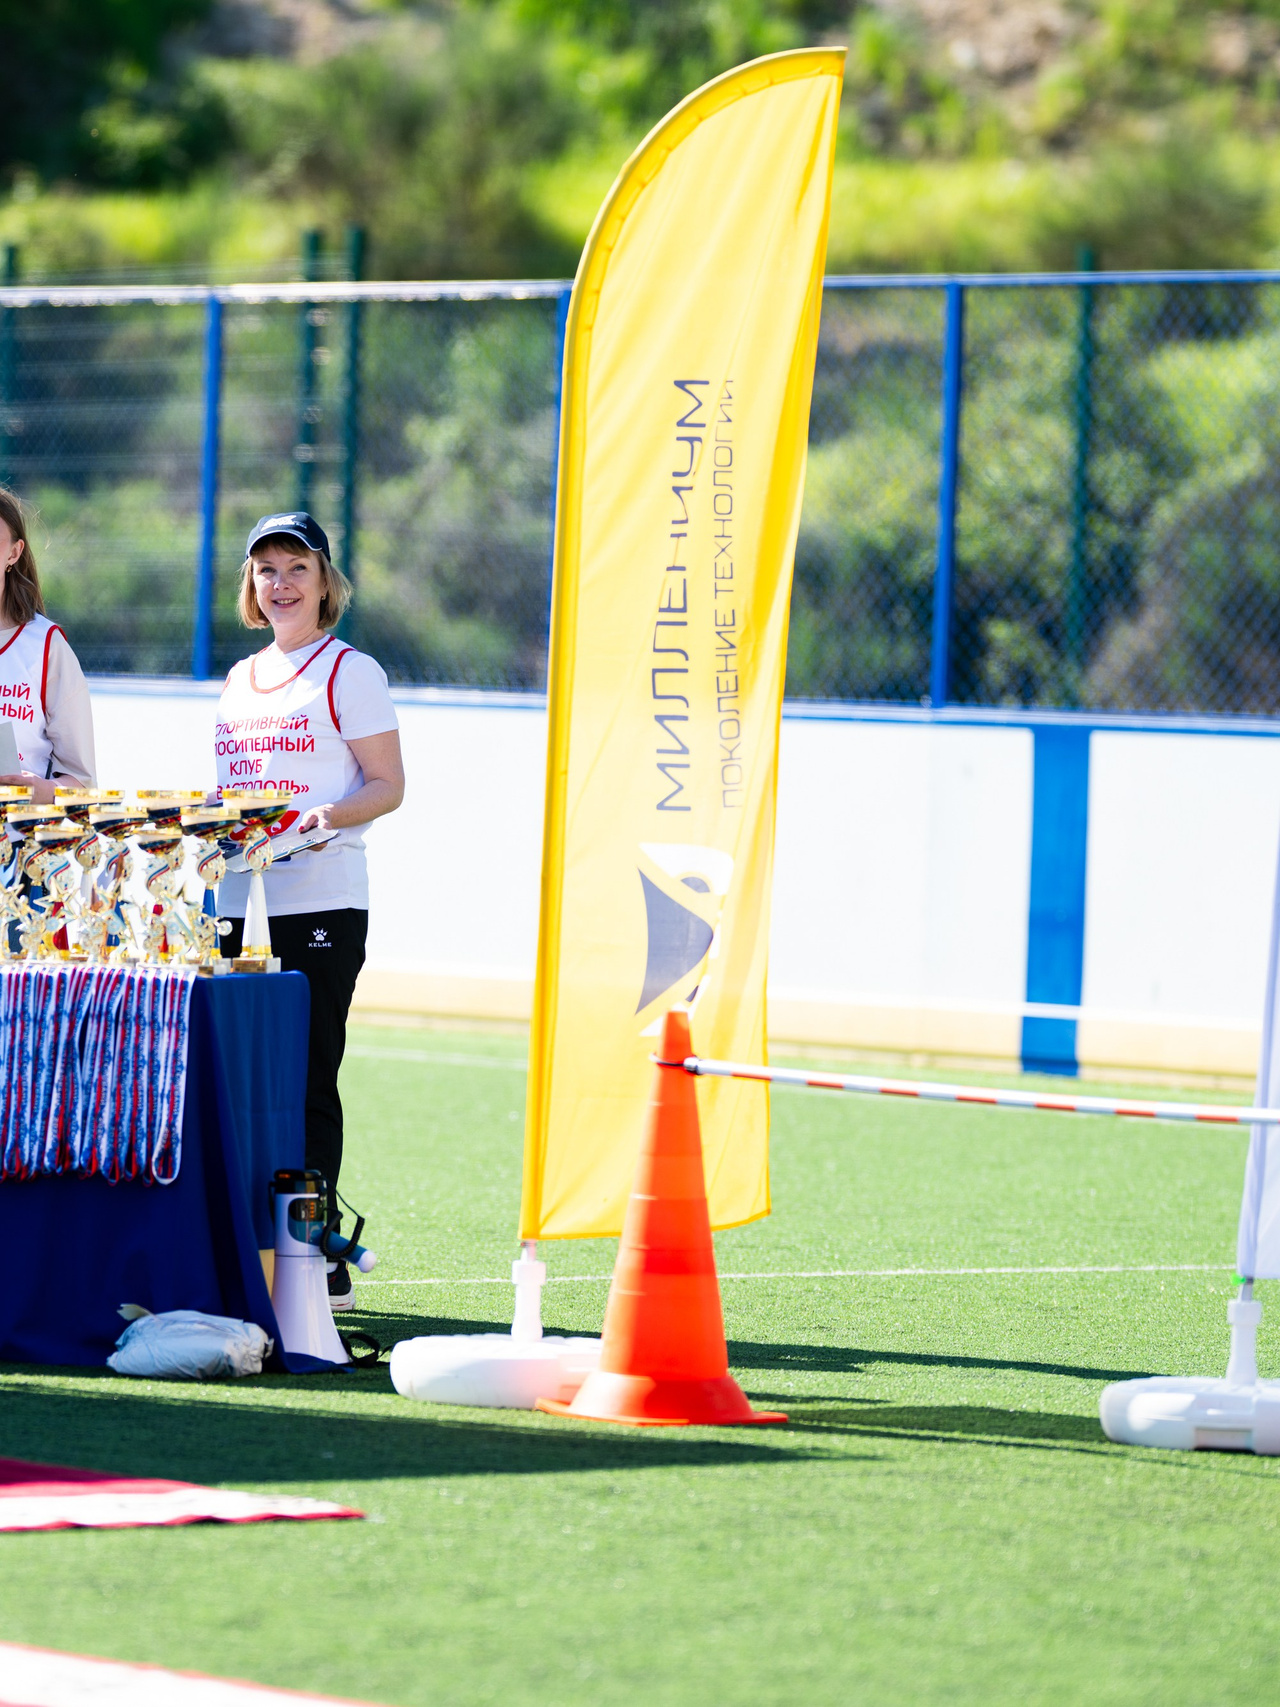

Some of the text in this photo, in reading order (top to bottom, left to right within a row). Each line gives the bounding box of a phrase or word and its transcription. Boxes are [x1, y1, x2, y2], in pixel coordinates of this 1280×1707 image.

[652, 379, 710, 811] МИЛЛЕНИУМ
[713, 380, 744, 808] ПОКОЛЕНИЕ ТЕХНОЛОГИИ
[215, 734, 315, 756] ОСИПЕДНЫЙ
[230, 759, 263, 776] КЛУБ
